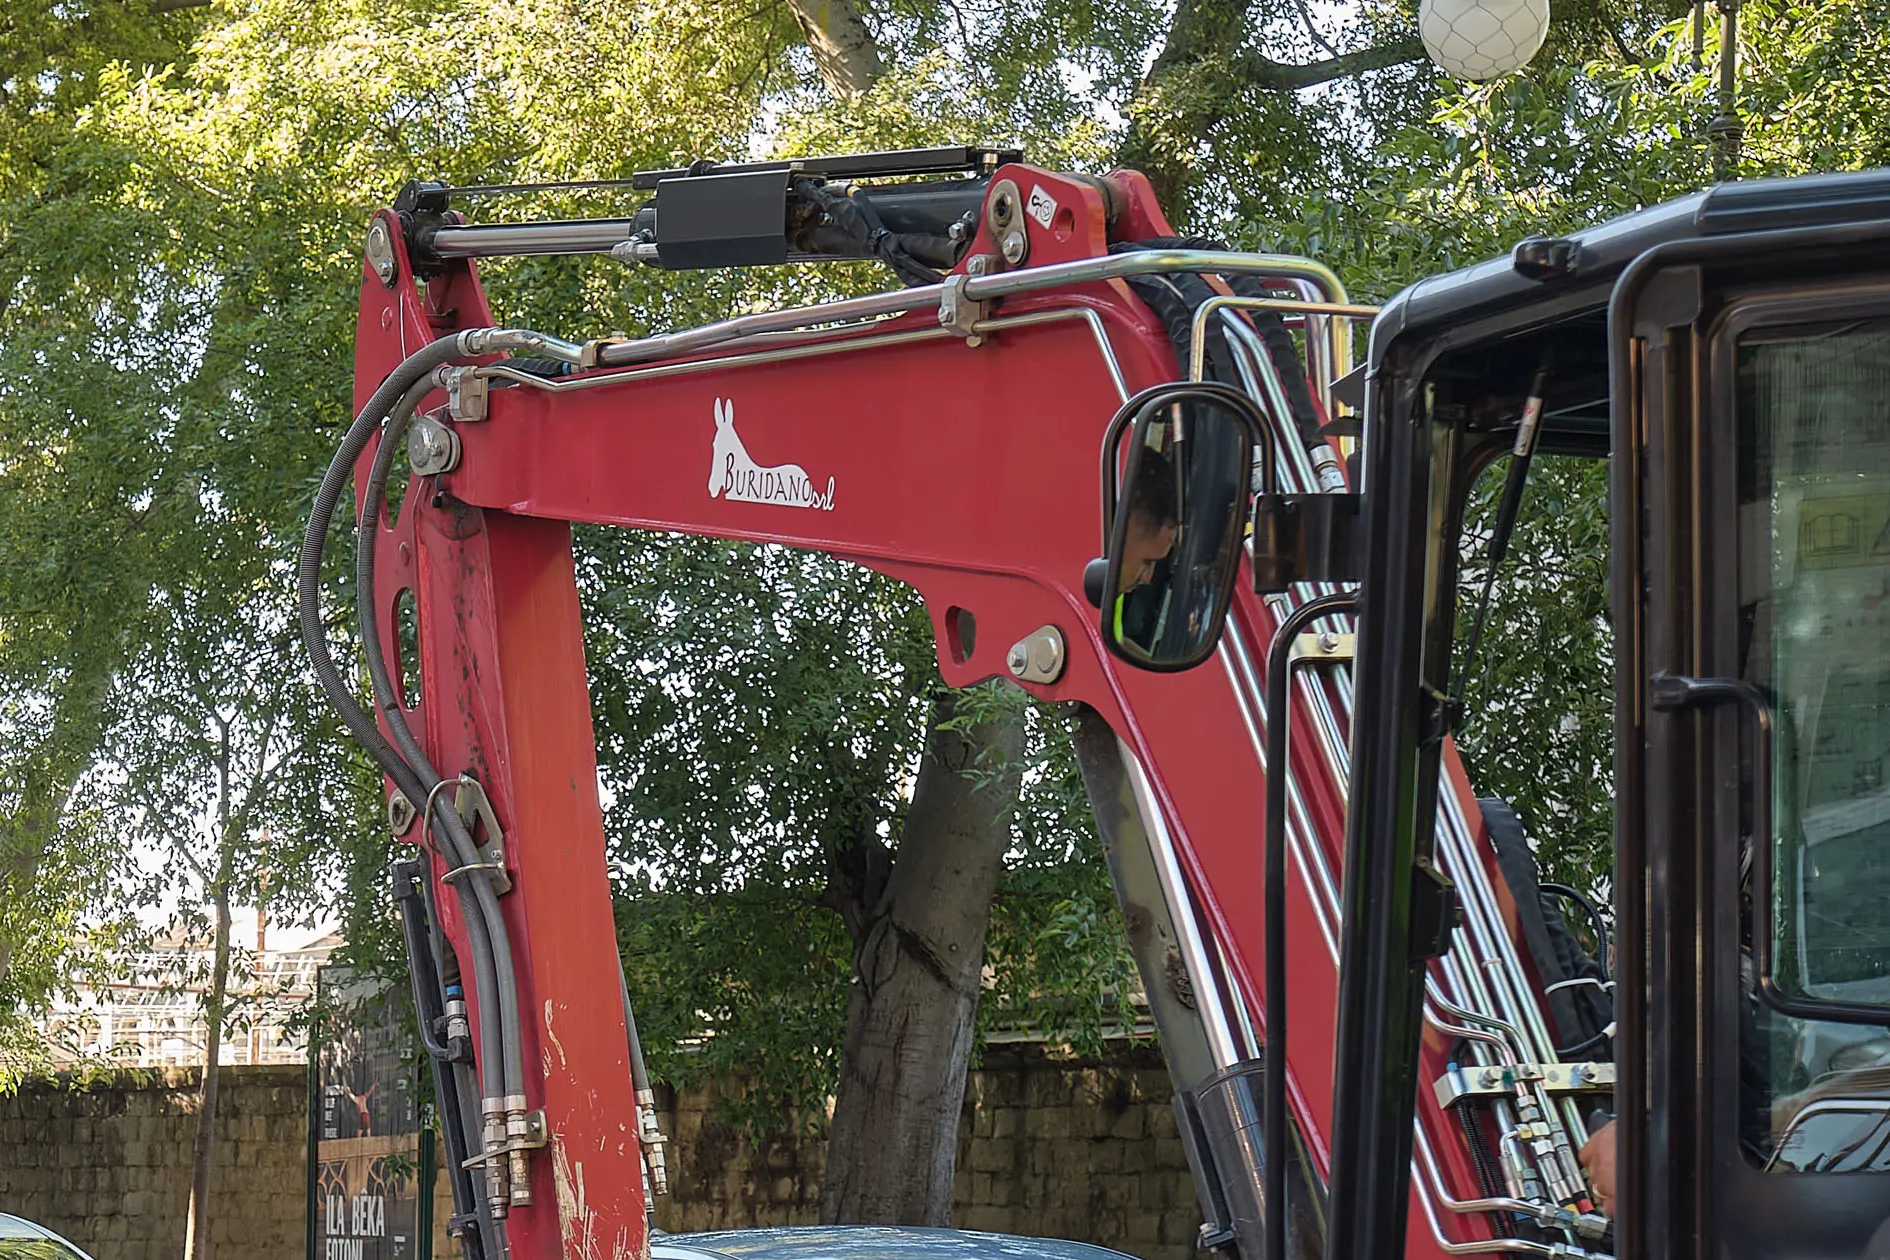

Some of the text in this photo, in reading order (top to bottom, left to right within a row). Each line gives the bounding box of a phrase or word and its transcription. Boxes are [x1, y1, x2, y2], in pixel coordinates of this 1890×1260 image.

[724, 452, 835, 511] BURIDANO srl
[326, 1187, 385, 1237] ILA BÊKA
